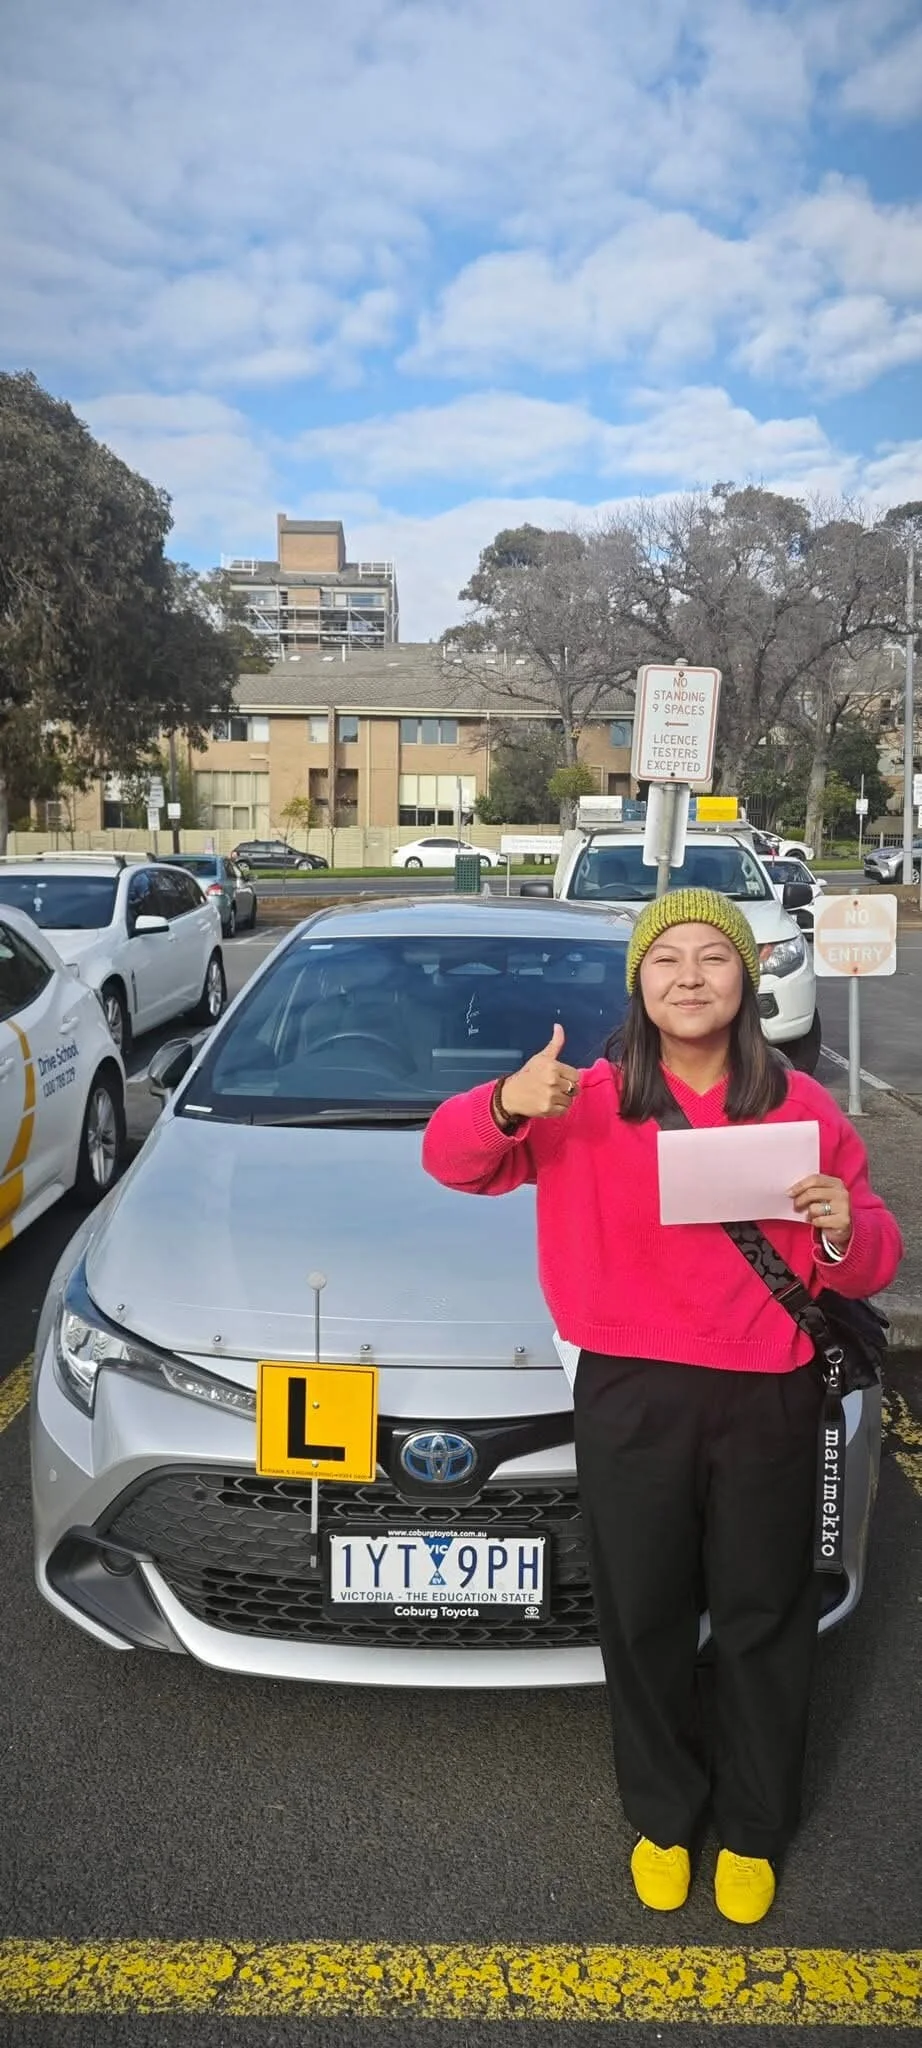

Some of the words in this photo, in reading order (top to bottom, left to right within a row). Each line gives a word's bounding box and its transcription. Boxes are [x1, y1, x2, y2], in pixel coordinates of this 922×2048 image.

[673, 677, 688, 688] NO
[653, 690, 706, 702] STANDING
[652, 703, 659, 713] 9
[664, 704, 705, 716] SPACES
[653, 734, 698, 746] LICENCE
[652, 747, 698, 759] TESTERS
[647, 760, 701, 772] EXCEPTED
[845, 909, 869, 925] NO
[828, 946, 882, 962] ENTRY
[38, 1055, 57, 1077] Drive
[56, 1039, 79, 1065] School
[287, 1377, 346, 1462] L
[822, 1429, 841, 1557] marimekko
[387, 1529, 487, 1538] www.coburgtoyota.com.au
[426, 1544, 448, 1555] VIC
[342, 1543, 417, 1588] 1YT
[458, 1545, 538, 1590] 9PH
[340, 1591, 394, 1601] VICTORIA
[406, 1592, 428, 1601] THE
[432, 1592, 497, 1601] EDUCATION
[501, 1593, 535, 1602] STATE
[394, 1606, 438, 1618] Coburg
[440, 1606, 479, 1619] Toyota
